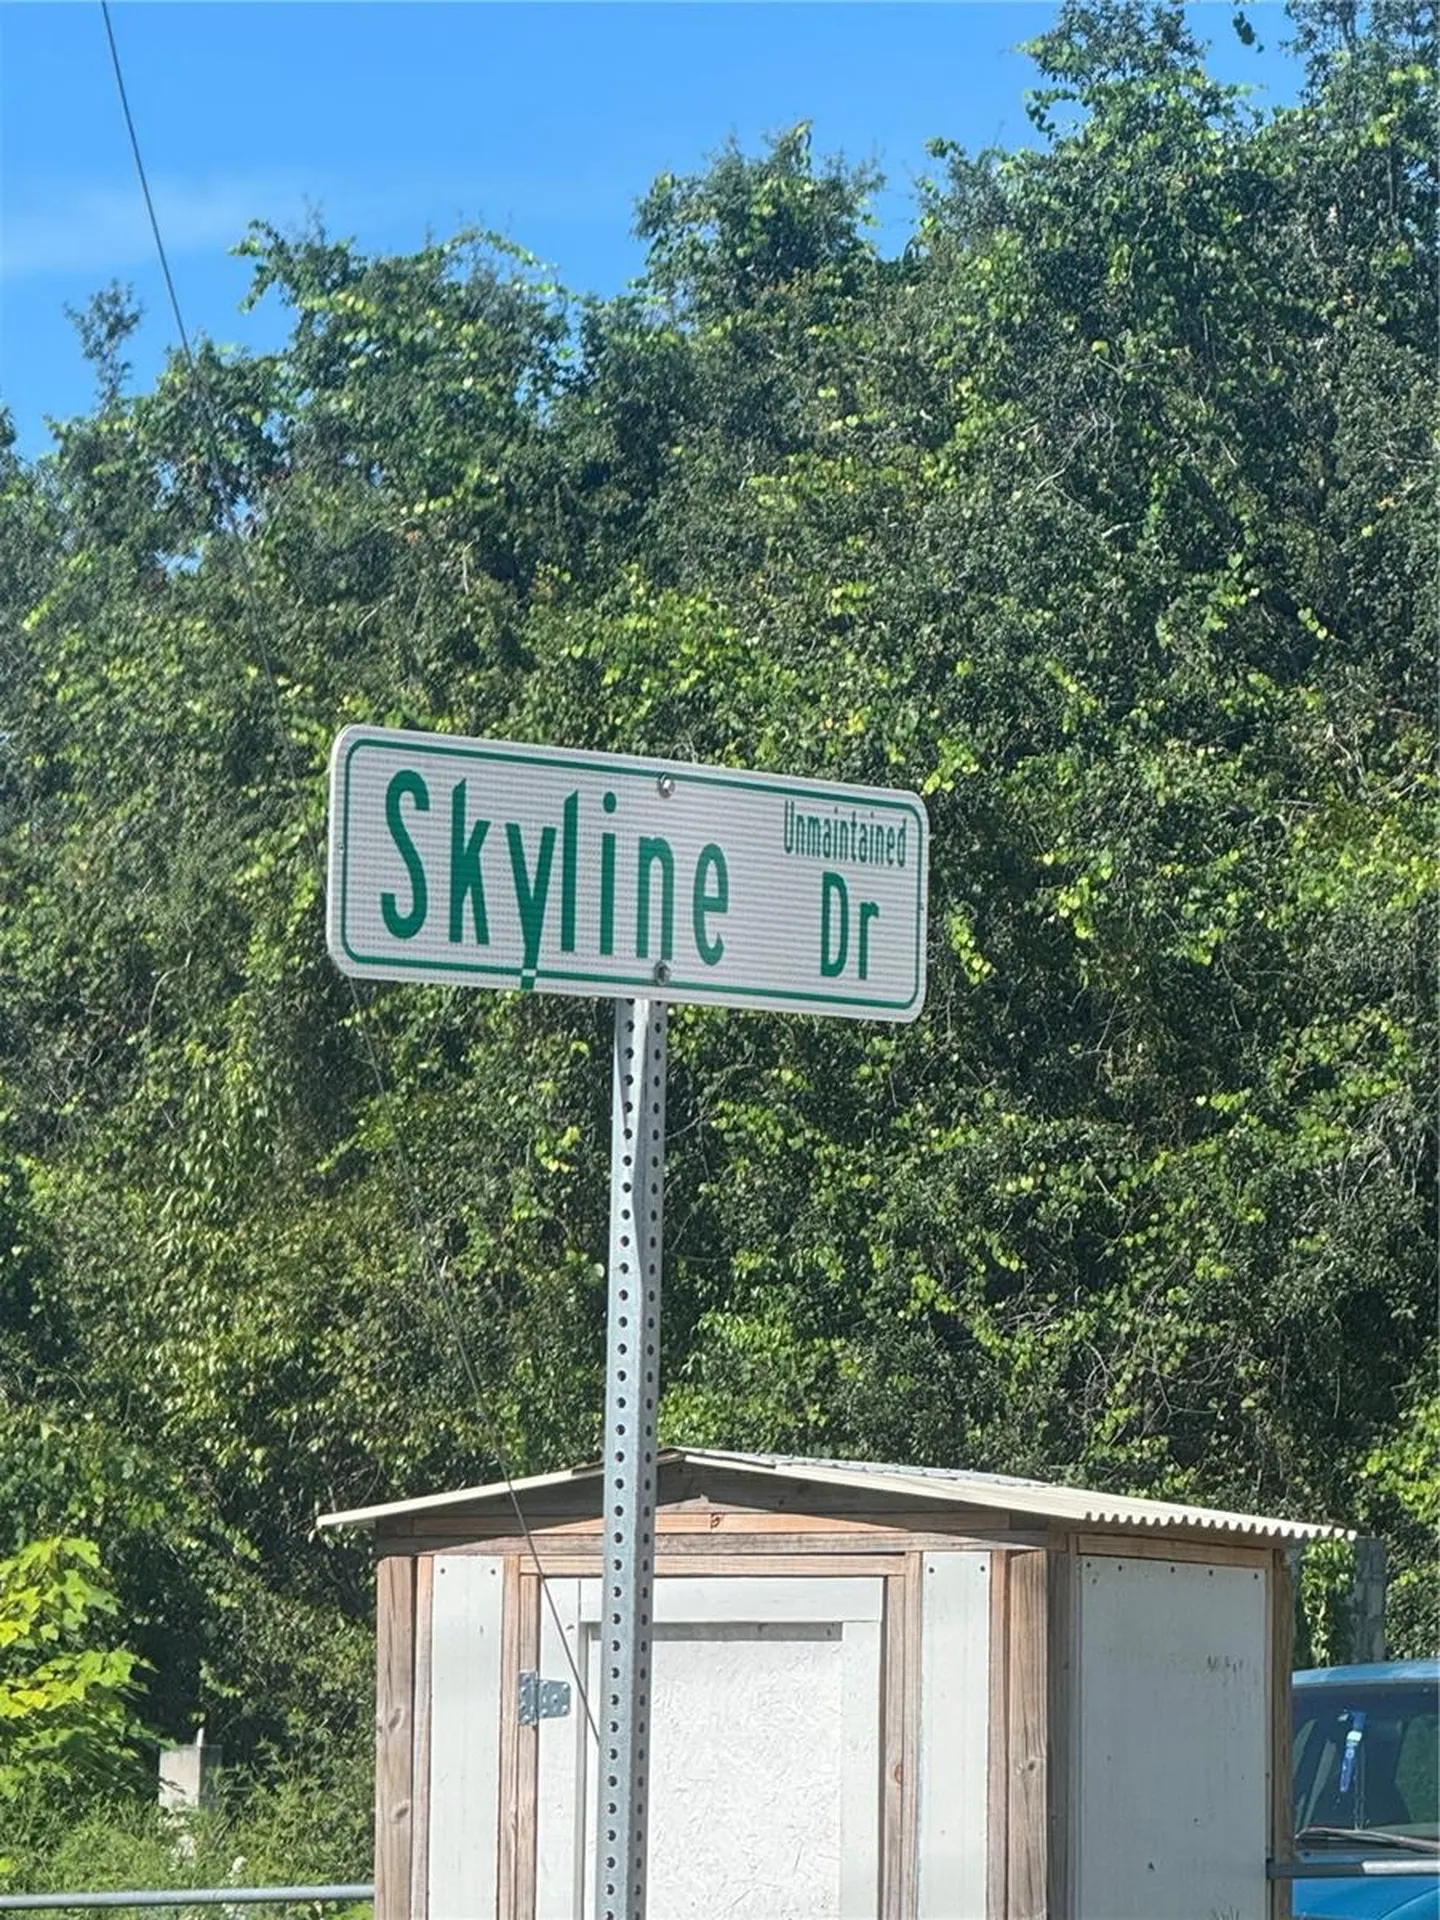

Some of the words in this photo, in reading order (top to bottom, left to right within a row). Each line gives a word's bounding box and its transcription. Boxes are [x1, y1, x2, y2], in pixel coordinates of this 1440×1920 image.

[380, 770, 729, 990] Skyline
[820, 872, 879, 980] Dr
[784, 800, 907, 868] Unmaintained
